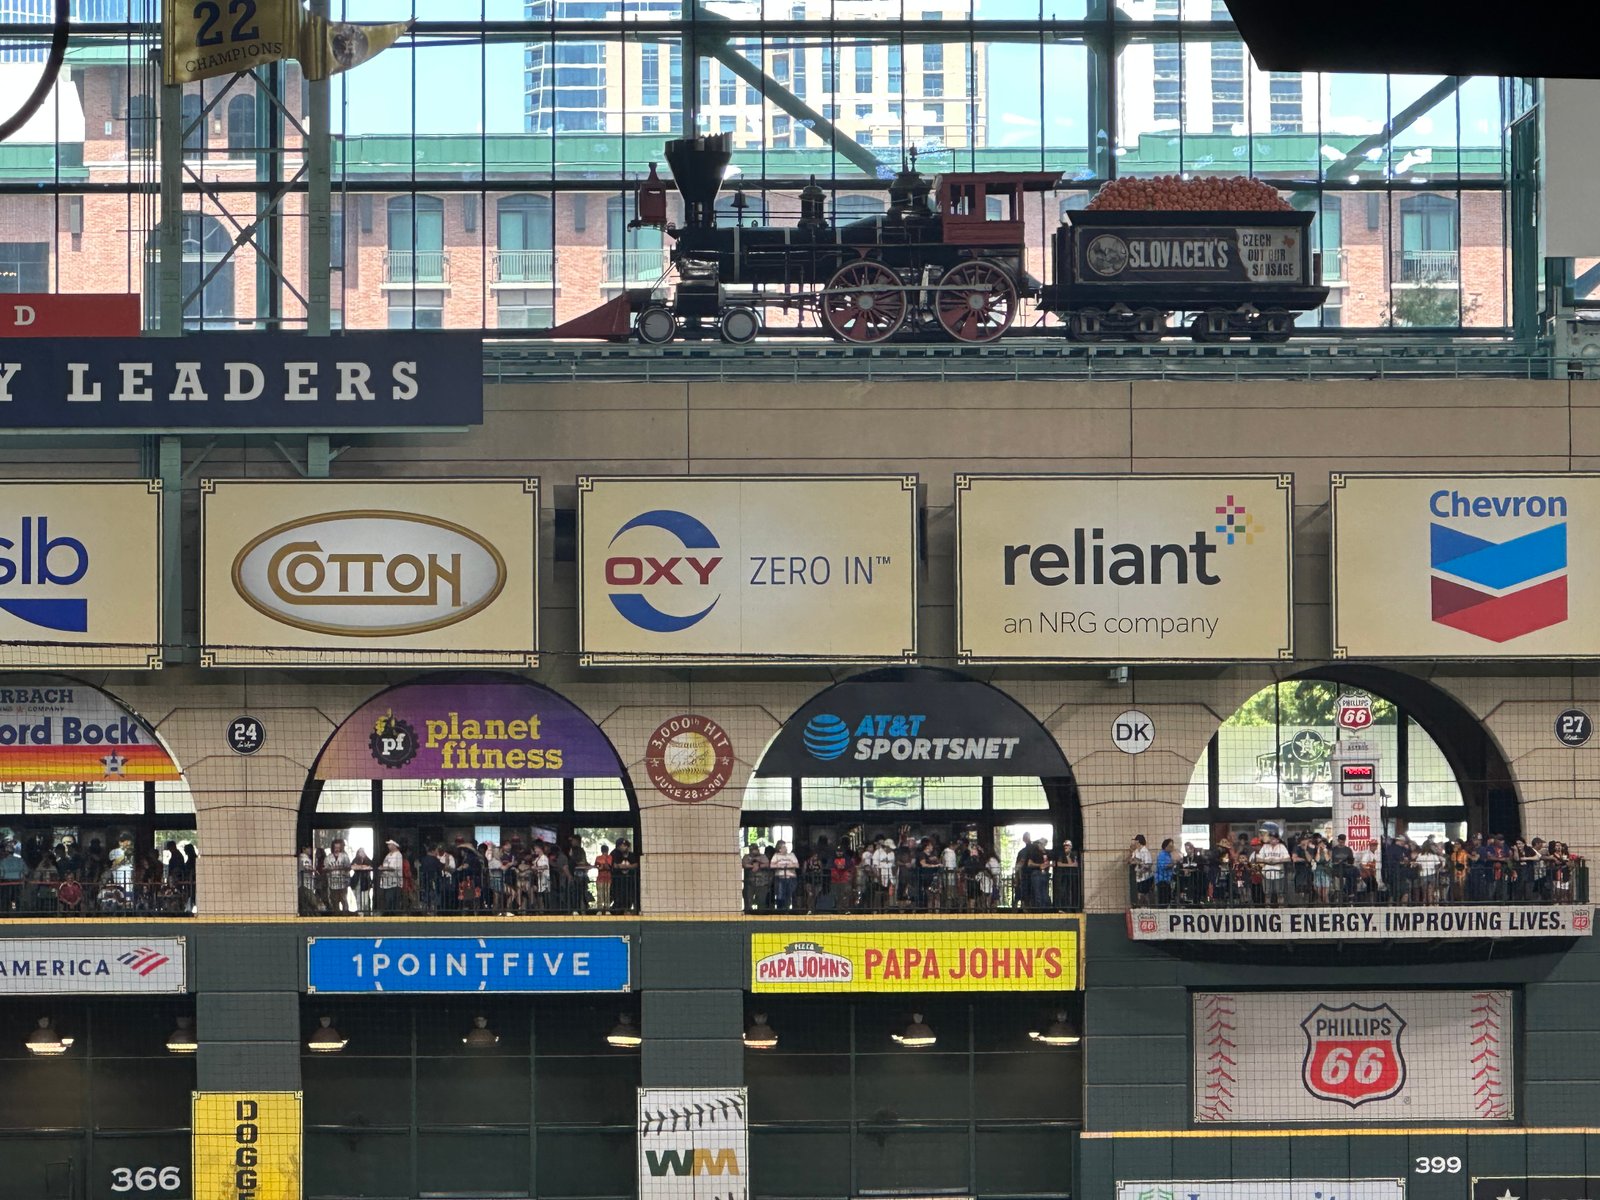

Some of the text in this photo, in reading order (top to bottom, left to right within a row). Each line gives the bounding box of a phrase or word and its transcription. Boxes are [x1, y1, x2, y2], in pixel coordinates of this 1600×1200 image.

[193, 0, 259, 47] 22
[185, 42, 283, 73] CHAMPIONS
[1129, 238, 1228, 268] SLOVACEK'S
[1242, 234, 1271, 247] CZECH
[1248, 249, 1285, 261] OUT OUR
[1252, 263, 1293, 276] SAUSAGE
[14, 305, 36, 326] D
[67, 361, 418, 401] LEADERS
[1429, 489, 1568, 518] Chevron
[1004, 528, 1222, 587] reliant
[267, 540, 462, 607] COTTON
[605, 557, 724, 586] OXY
[749, 556, 831, 585] ZERO
[1004, 611, 1219, 639] an NRG company
[854, 714, 927, 737] AT&T
[1344, 709, 1367, 723] 66
[1563, 716, 1584, 733] 27
[0, 716, 140, 745] ord Bock
[234, 723, 257, 741] 24
[425, 712, 541, 749] planet
[704, 722, 729, 748] HIT
[1115, 723, 1152, 743] DK
[381, 733, 406, 756] pf
[441, 741, 563, 770] fitness
[853, 737, 1019, 761] SPORTSNET
[655, 775, 682, 797] JUNE
[1347, 815, 1370, 826] HOME
[1351, 828, 1368, 837] RUN
[1169, 911, 1567, 933] PROVIDING ENERGY. IMPROVING LIVES.
[352, 952, 590, 977] 1POINTFIVE
[759, 956, 850, 978] PAPA JOHN'S
[865, 947, 1063, 980] PAPA JOHN'S
[1316, 1017, 1391, 1037] PHILLIPS
[1320, 1046, 1384, 1086] 66
[645, 1148, 740, 1177] WM
[1414, 1155, 1462, 1175] 399
[111, 1165, 180, 1192] 366
